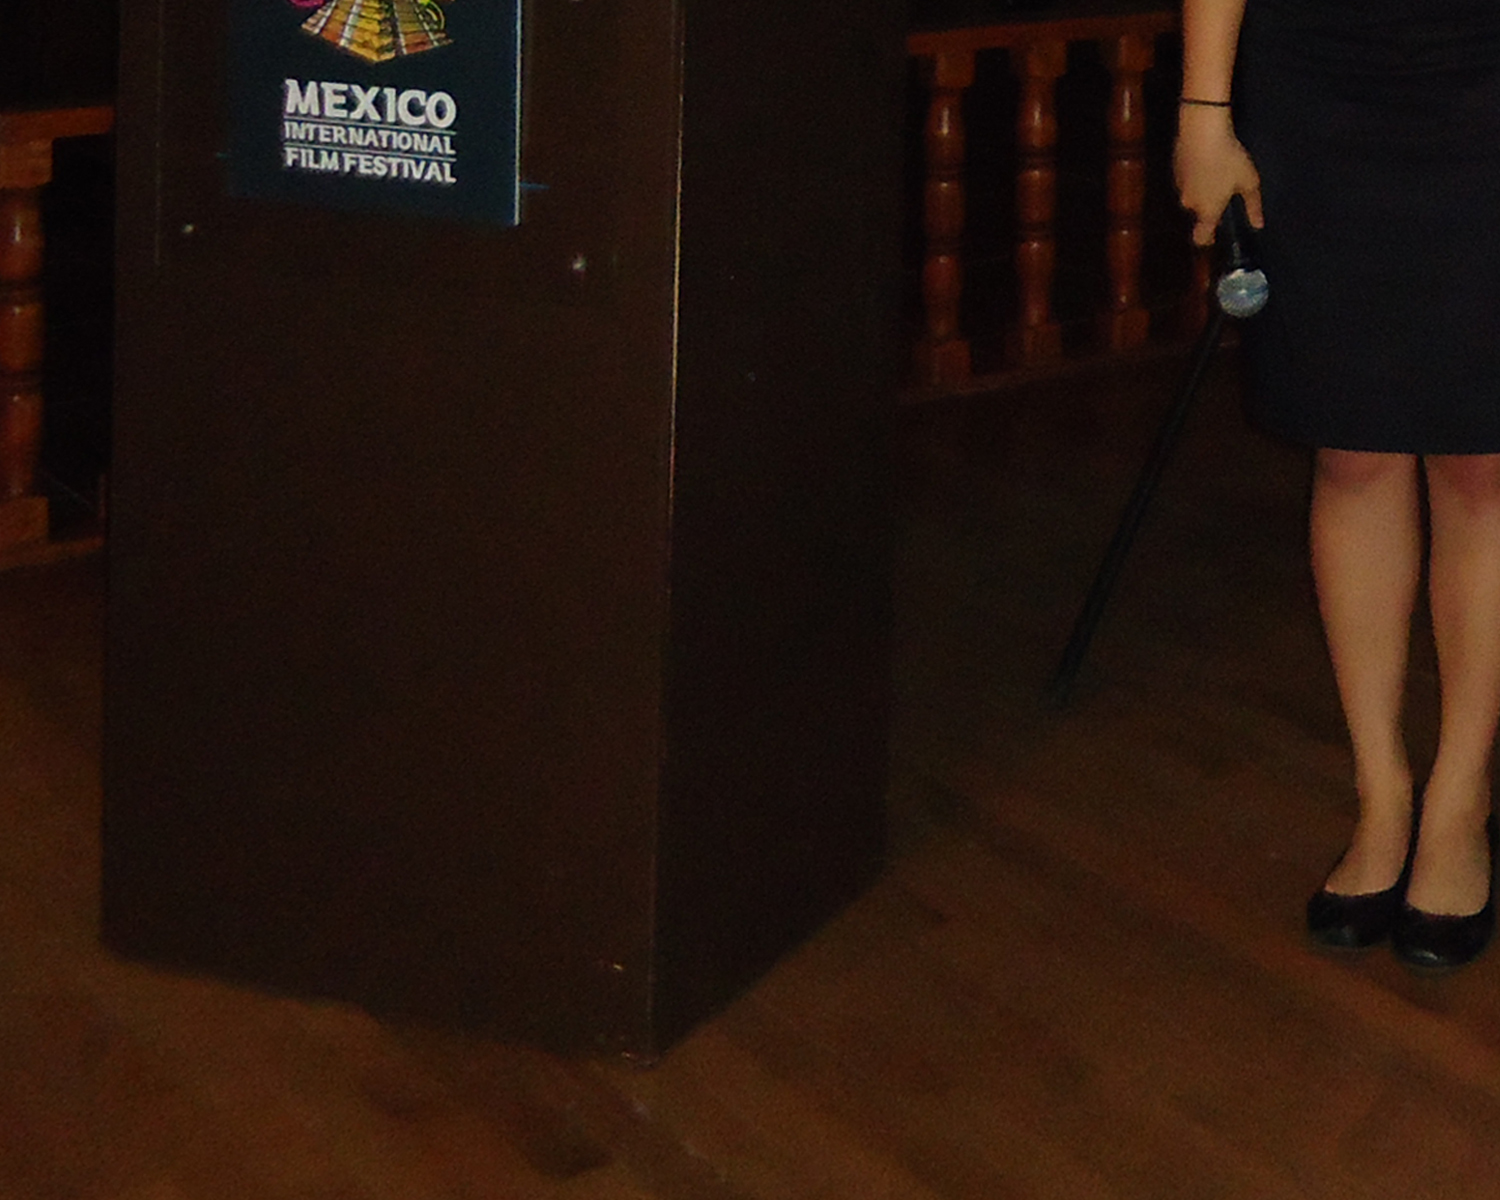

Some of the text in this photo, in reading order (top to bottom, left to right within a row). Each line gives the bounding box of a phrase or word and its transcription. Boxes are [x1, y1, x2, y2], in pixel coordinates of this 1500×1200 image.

[285, 79, 457, 129] MEXICO
[284, 121, 457, 155] INTERNATIONAL
[284, 147, 457, 184] FILM FESTIVAL
